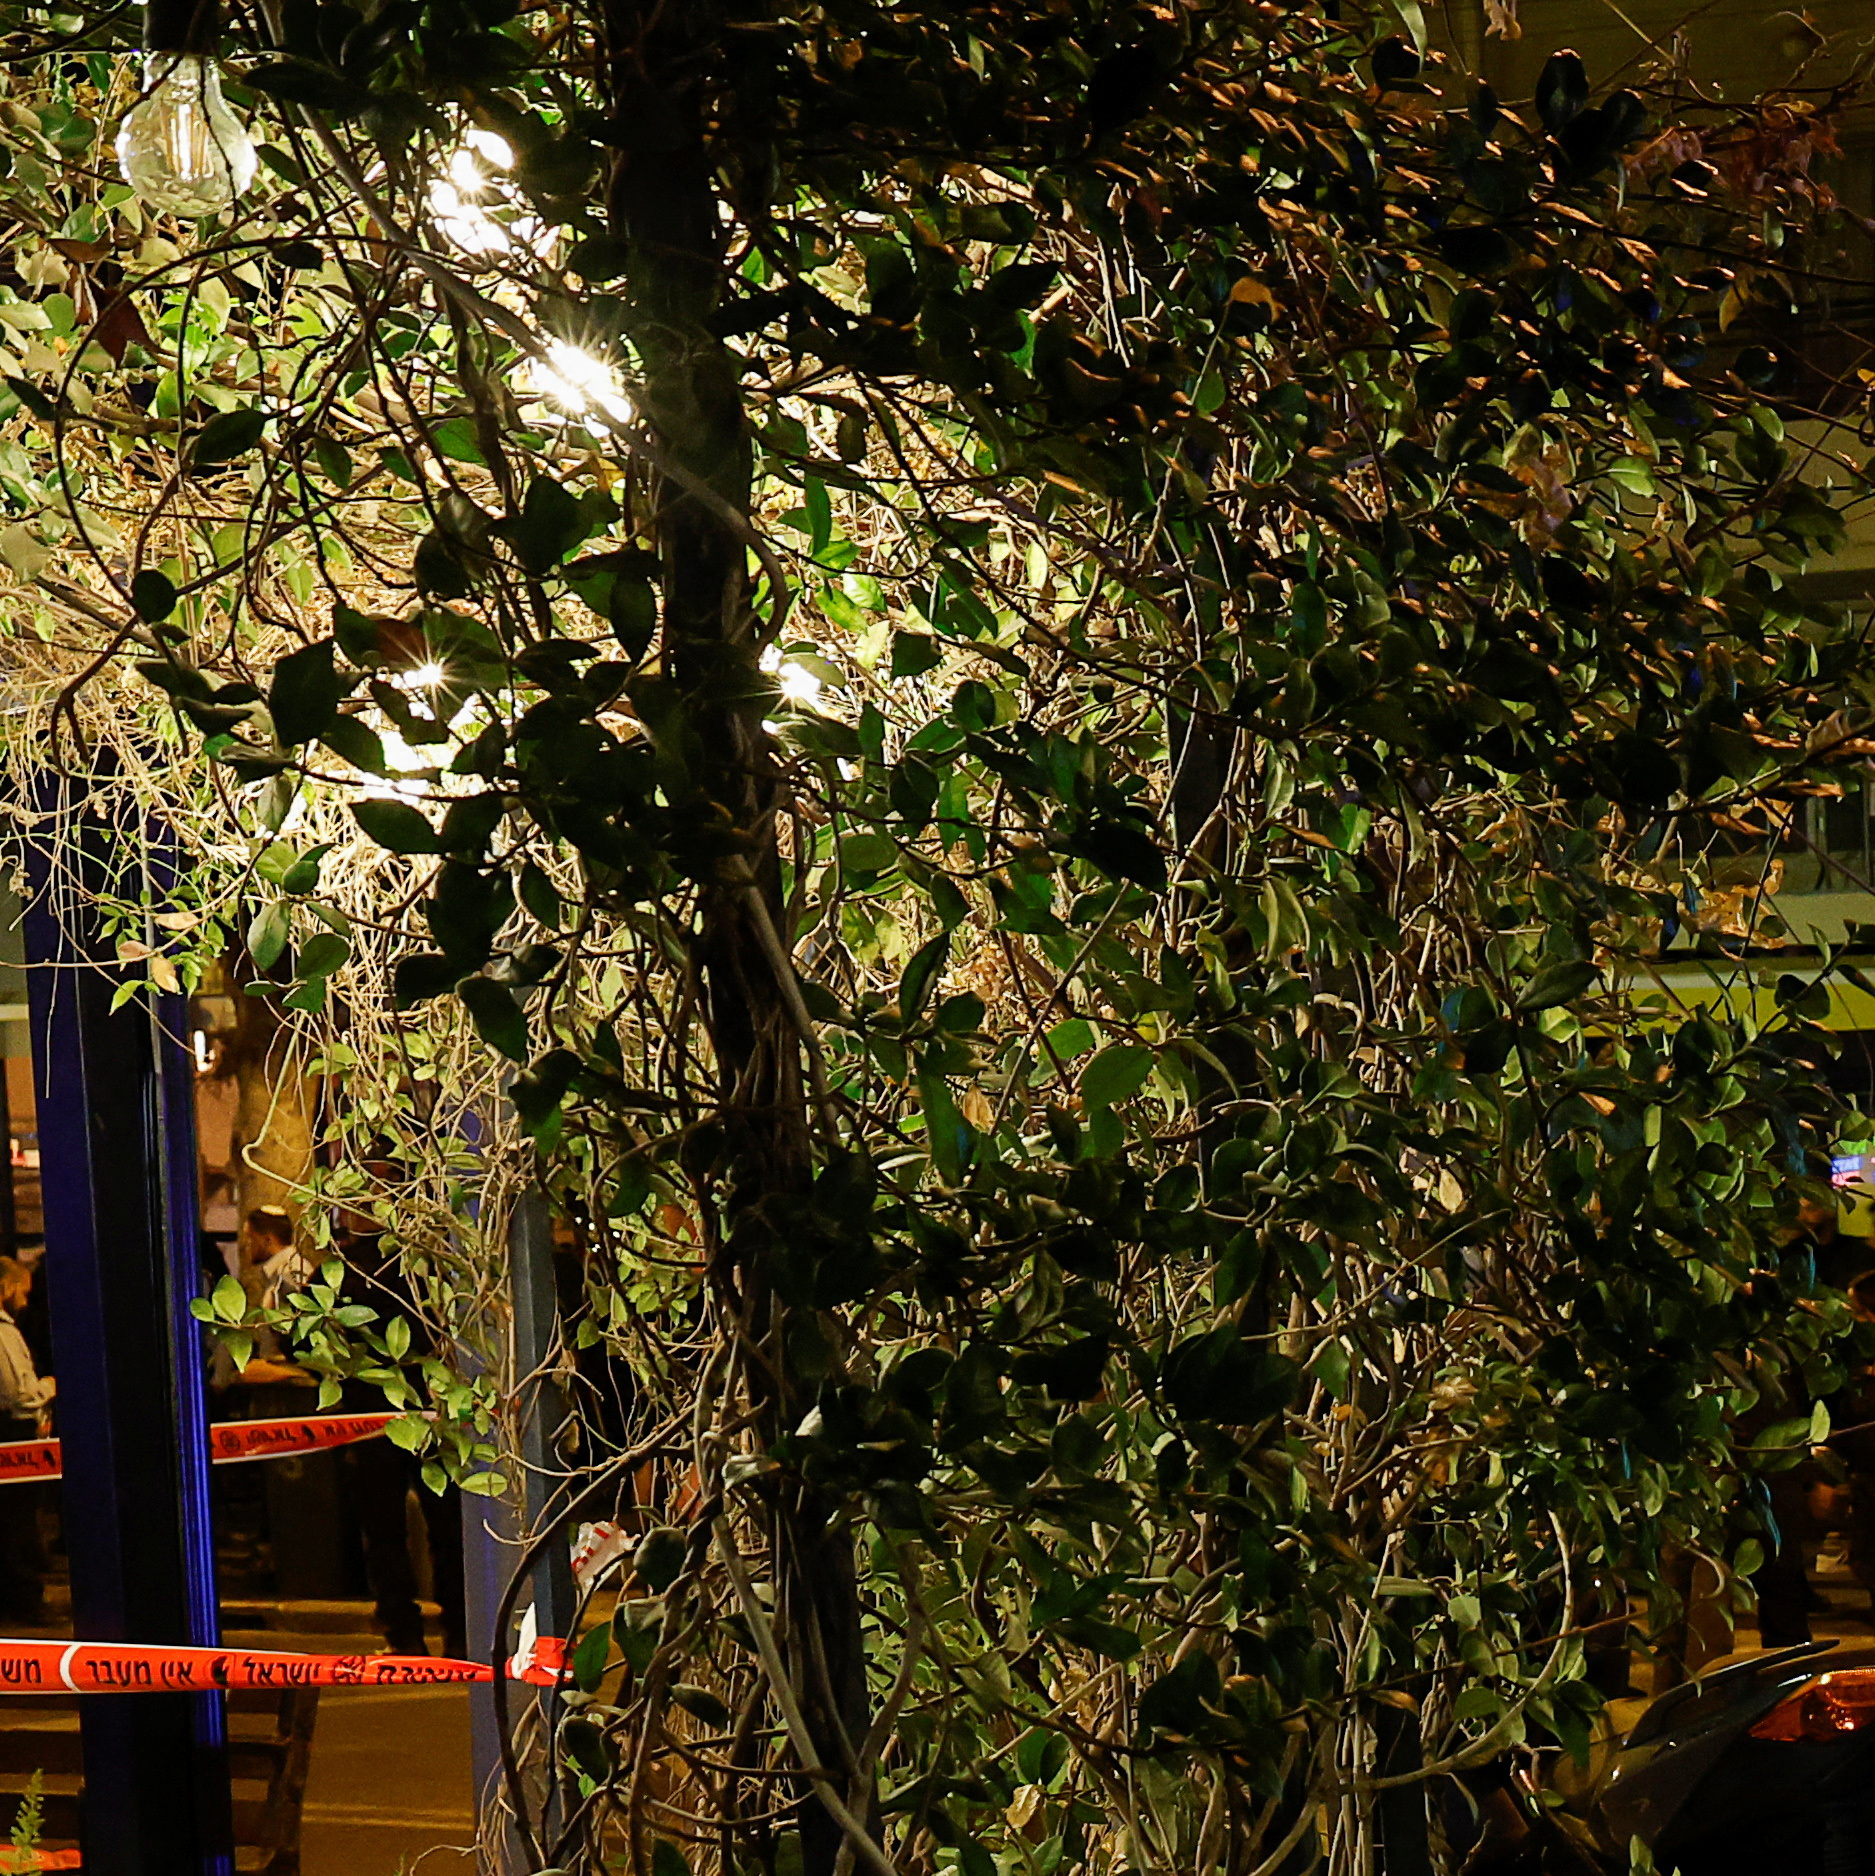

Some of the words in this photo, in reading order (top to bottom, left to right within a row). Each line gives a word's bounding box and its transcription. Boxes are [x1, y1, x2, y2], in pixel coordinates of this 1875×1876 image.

[86, 1660, 152, 1686] מעבר
[161, 1659, 195, 1690] אין
[242, 1655, 321, 1686] ישראל
